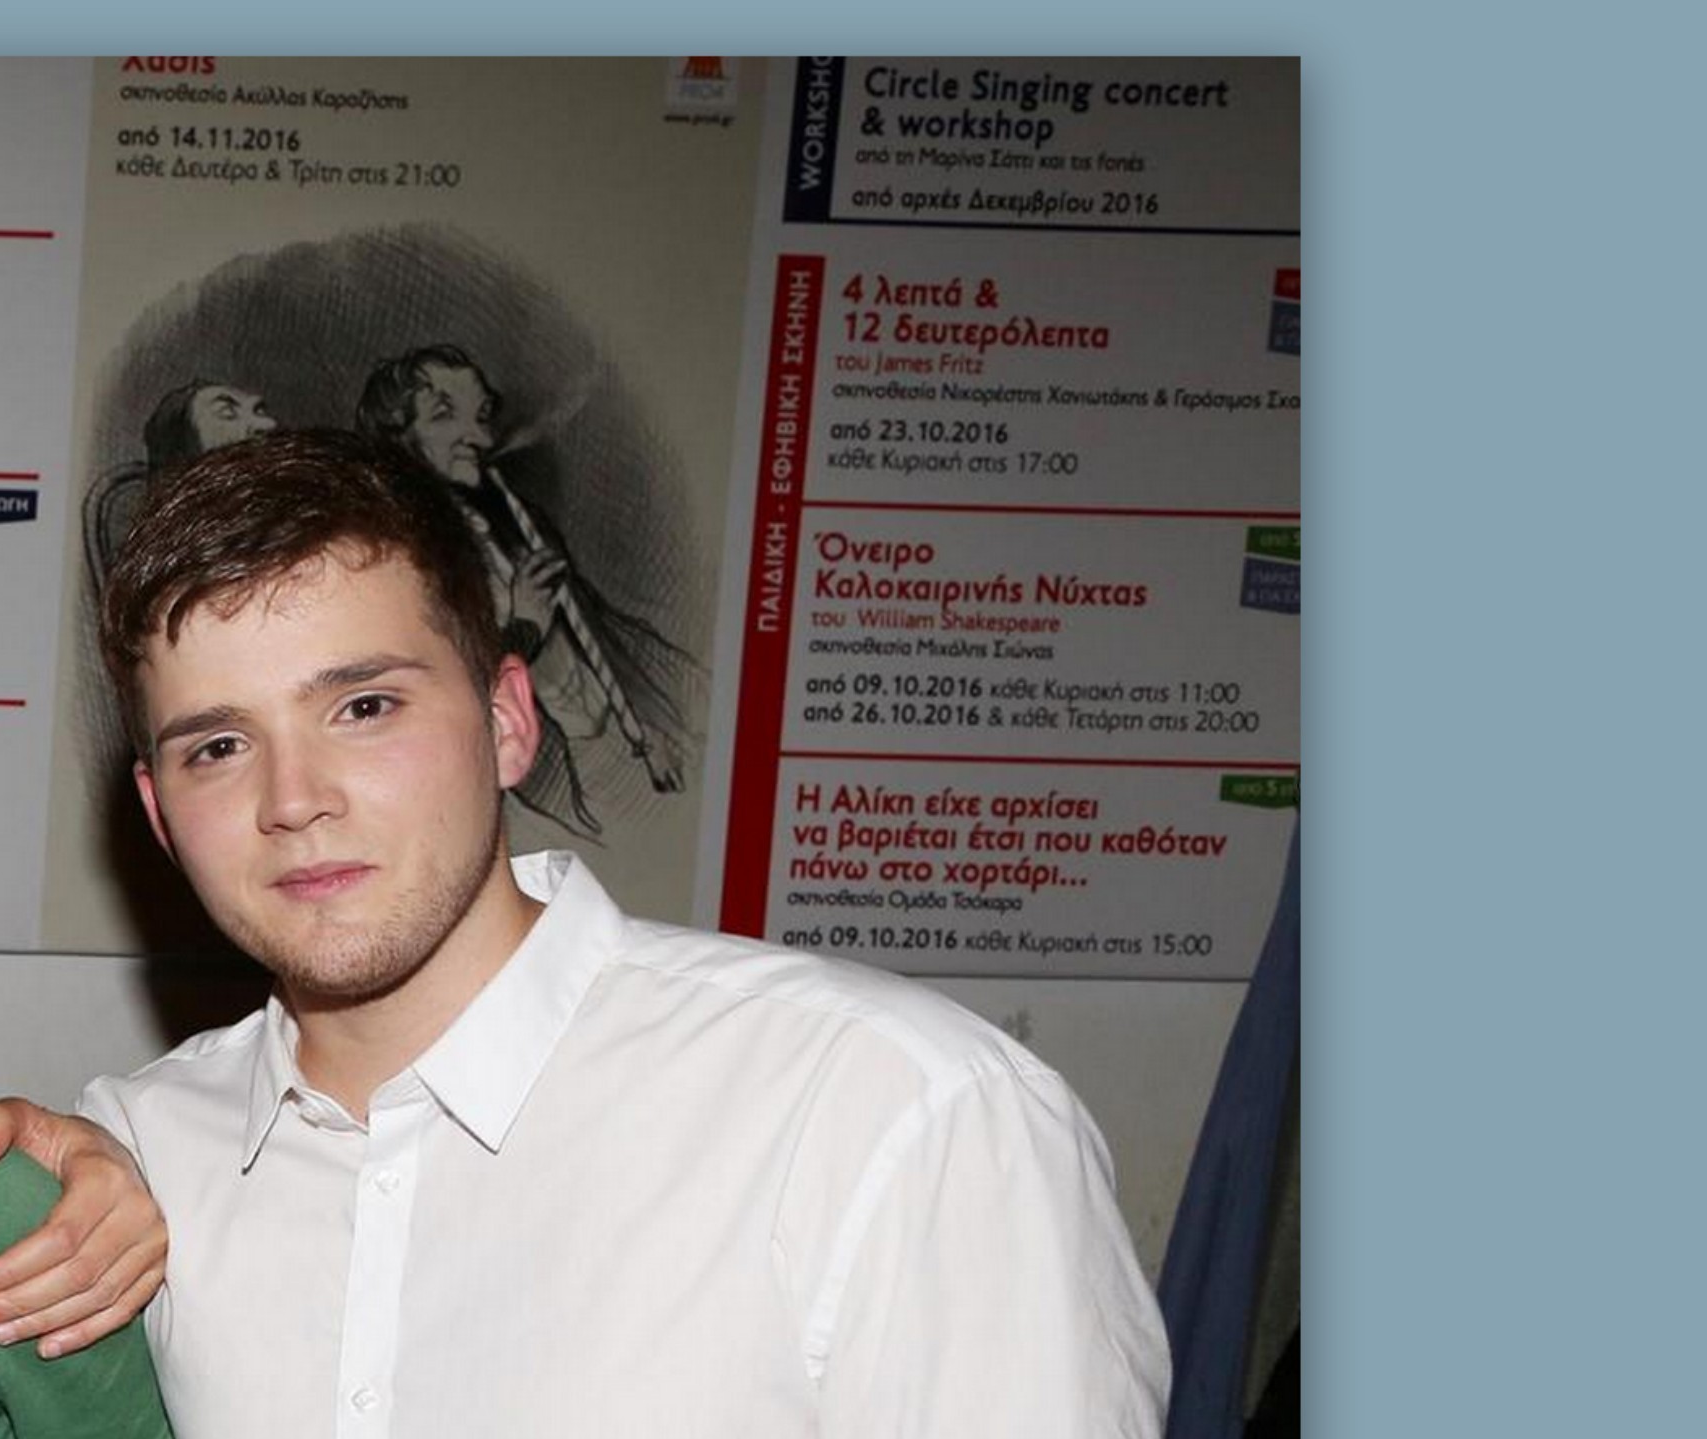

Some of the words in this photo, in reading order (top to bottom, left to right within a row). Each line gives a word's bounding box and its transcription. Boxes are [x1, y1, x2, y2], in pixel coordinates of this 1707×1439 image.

[864, 66, 959, 101] Circle
[970, 68, 1093, 112] Singing
[1104, 80, 1229, 107] concert
[117, 125, 160, 147] από
[171, 125, 300, 152] 14.11.2016
[860, 106, 884, 136] &
[897, 108, 1054, 150] workshop
[115, 153, 165, 177] κάθε
[170, 154, 258, 185] Δευτέρα
[264, 158, 281, 181] &
[288, 158, 342, 187] Τρίτη
[394, 161, 461, 188] 21:00
[851, 186, 893, 208] από
[900, 188, 961, 213] αρχές
[967, 188, 1094, 217] Δεκεμβρίου
[1100, 191, 1158, 215] 2016
[842, 274, 863, 304] 4
[874, 274, 962, 307] λεπτά
[974, 278, 998, 308] &
[783, 270, 812, 364] ΣΚΗΝΗ
[844, 311, 881, 343] 12
[893, 312, 1109, 354] δευτερόλεπτα
[834, 354, 870, 372] του
[874, 351, 933, 376] James
[938, 352, 984, 375] Fritz
[771, 375, 801, 493] ΕΦΗΒΙΚΗ
[829, 419, 871, 441] από
[878, 418, 1008, 444] 23.10.2016
[827, 446, 876, 470] κάθε
[881, 448, 963, 475] Κυριακή
[1017, 451, 1078, 475] 17:00
[813, 531, 934, 570] Όνειρο
[757, 522, 787, 631] ΠΑΙΔΙΚΗ
[815, 568, 1023, 610] Καλοκαιρινής
[1035, 574, 1147, 606] Νύχτας
[811, 611, 846, 628] του
[857, 607, 934, 630] William
[940, 608, 1060, 636] Shakespeare
[805, 673, 846, 695] από
[853, 673, 982, 698] 09.10.2016
[989, 677, 1038, 700] κάθε
[1043, 678, 1124, 706] Κυριακή
[1180, 681, 1240, 705] 11:00
[803, 701, 844, 722] από
[850, 700, 980, 726] 26.10.2016
[987, 705, 1003, 726] &
[1010, 705, 1059, 728] κάθε
[1065, 705, 1143, 734] Τετάρτη
[1194, 709, 1259, 733] 20:00
[796, 783, 821, 812] Η
[830, 784, 914, 815] Αλίκη
[924, 787, 981, 817] είχε
[990, 790, 1098, 826] αρχίσει
[793, 825, 828, 846] να
[837, 818, 957, 856] βαριέται
[967, 820, 1025, 851] έτσι
[1034, 831, 1091, 853] που
[1101, 825, 1227, 856] καθόταν
[789, 850, 868, 881] πάνω
[879, 860, 933, 882] στο
[781, 926, 823, 946] από
[829, 925, 957, 950] 09.10.2016
[965, 929, 1012, 952] κάθε
[1017, 930, 1098, 957] Κυριακή
[1152, 932, 1213, 956] 15:00
